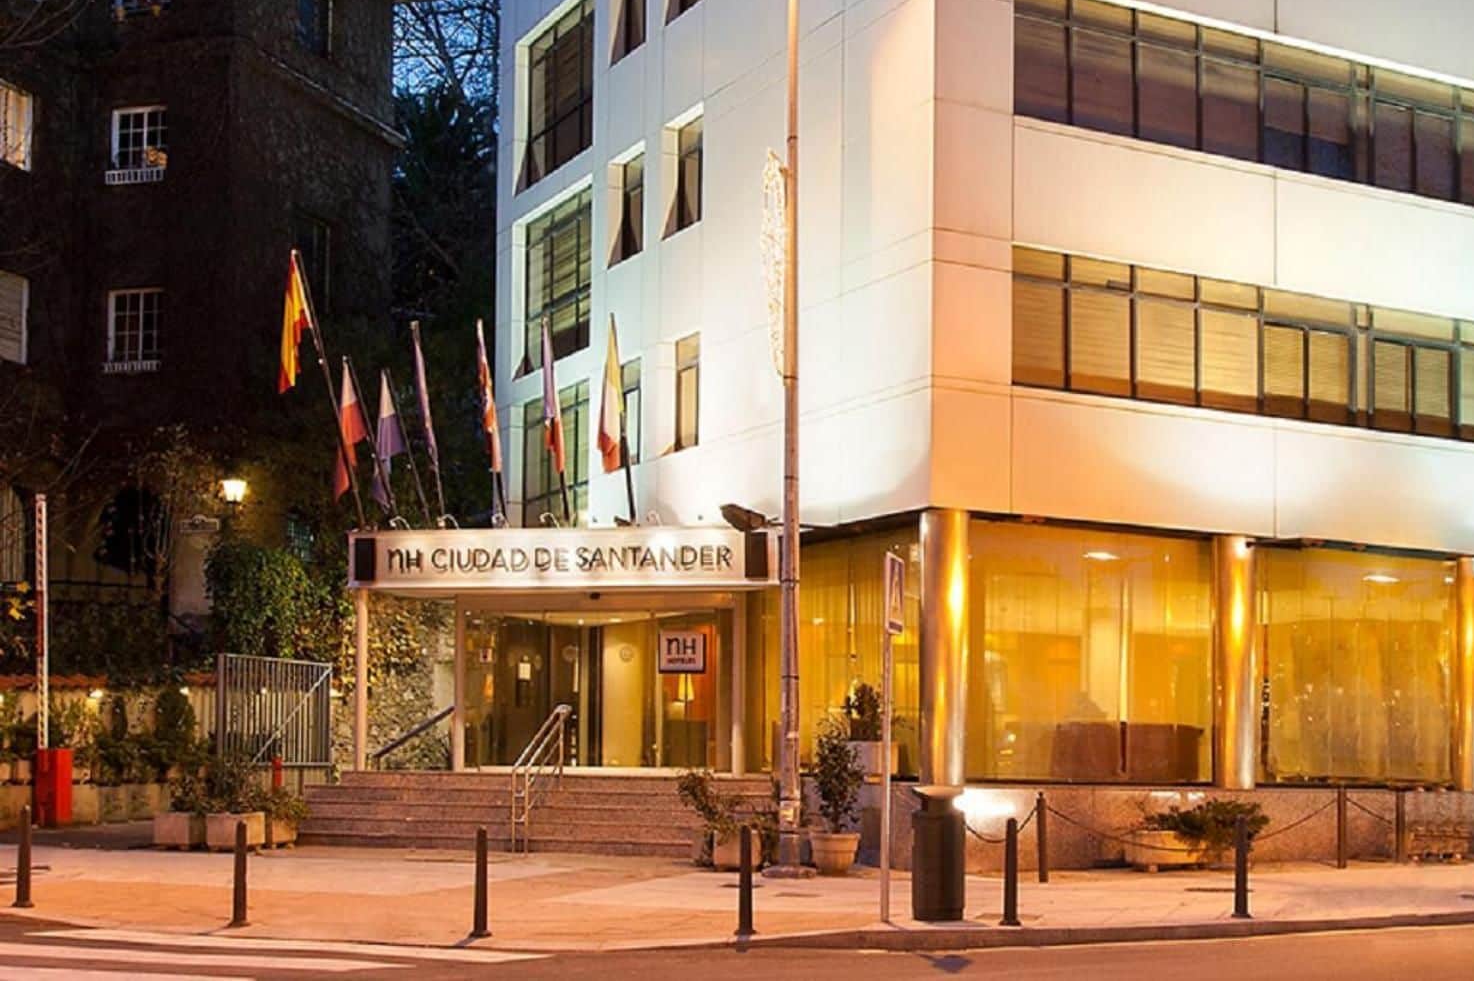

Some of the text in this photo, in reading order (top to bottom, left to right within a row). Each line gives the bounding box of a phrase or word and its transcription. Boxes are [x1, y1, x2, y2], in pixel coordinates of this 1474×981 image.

[431, 547, 529, 573] CIUDAD
[534, 547, 569, 572] DE
[576, 545, 733, 572] SANTANDER
